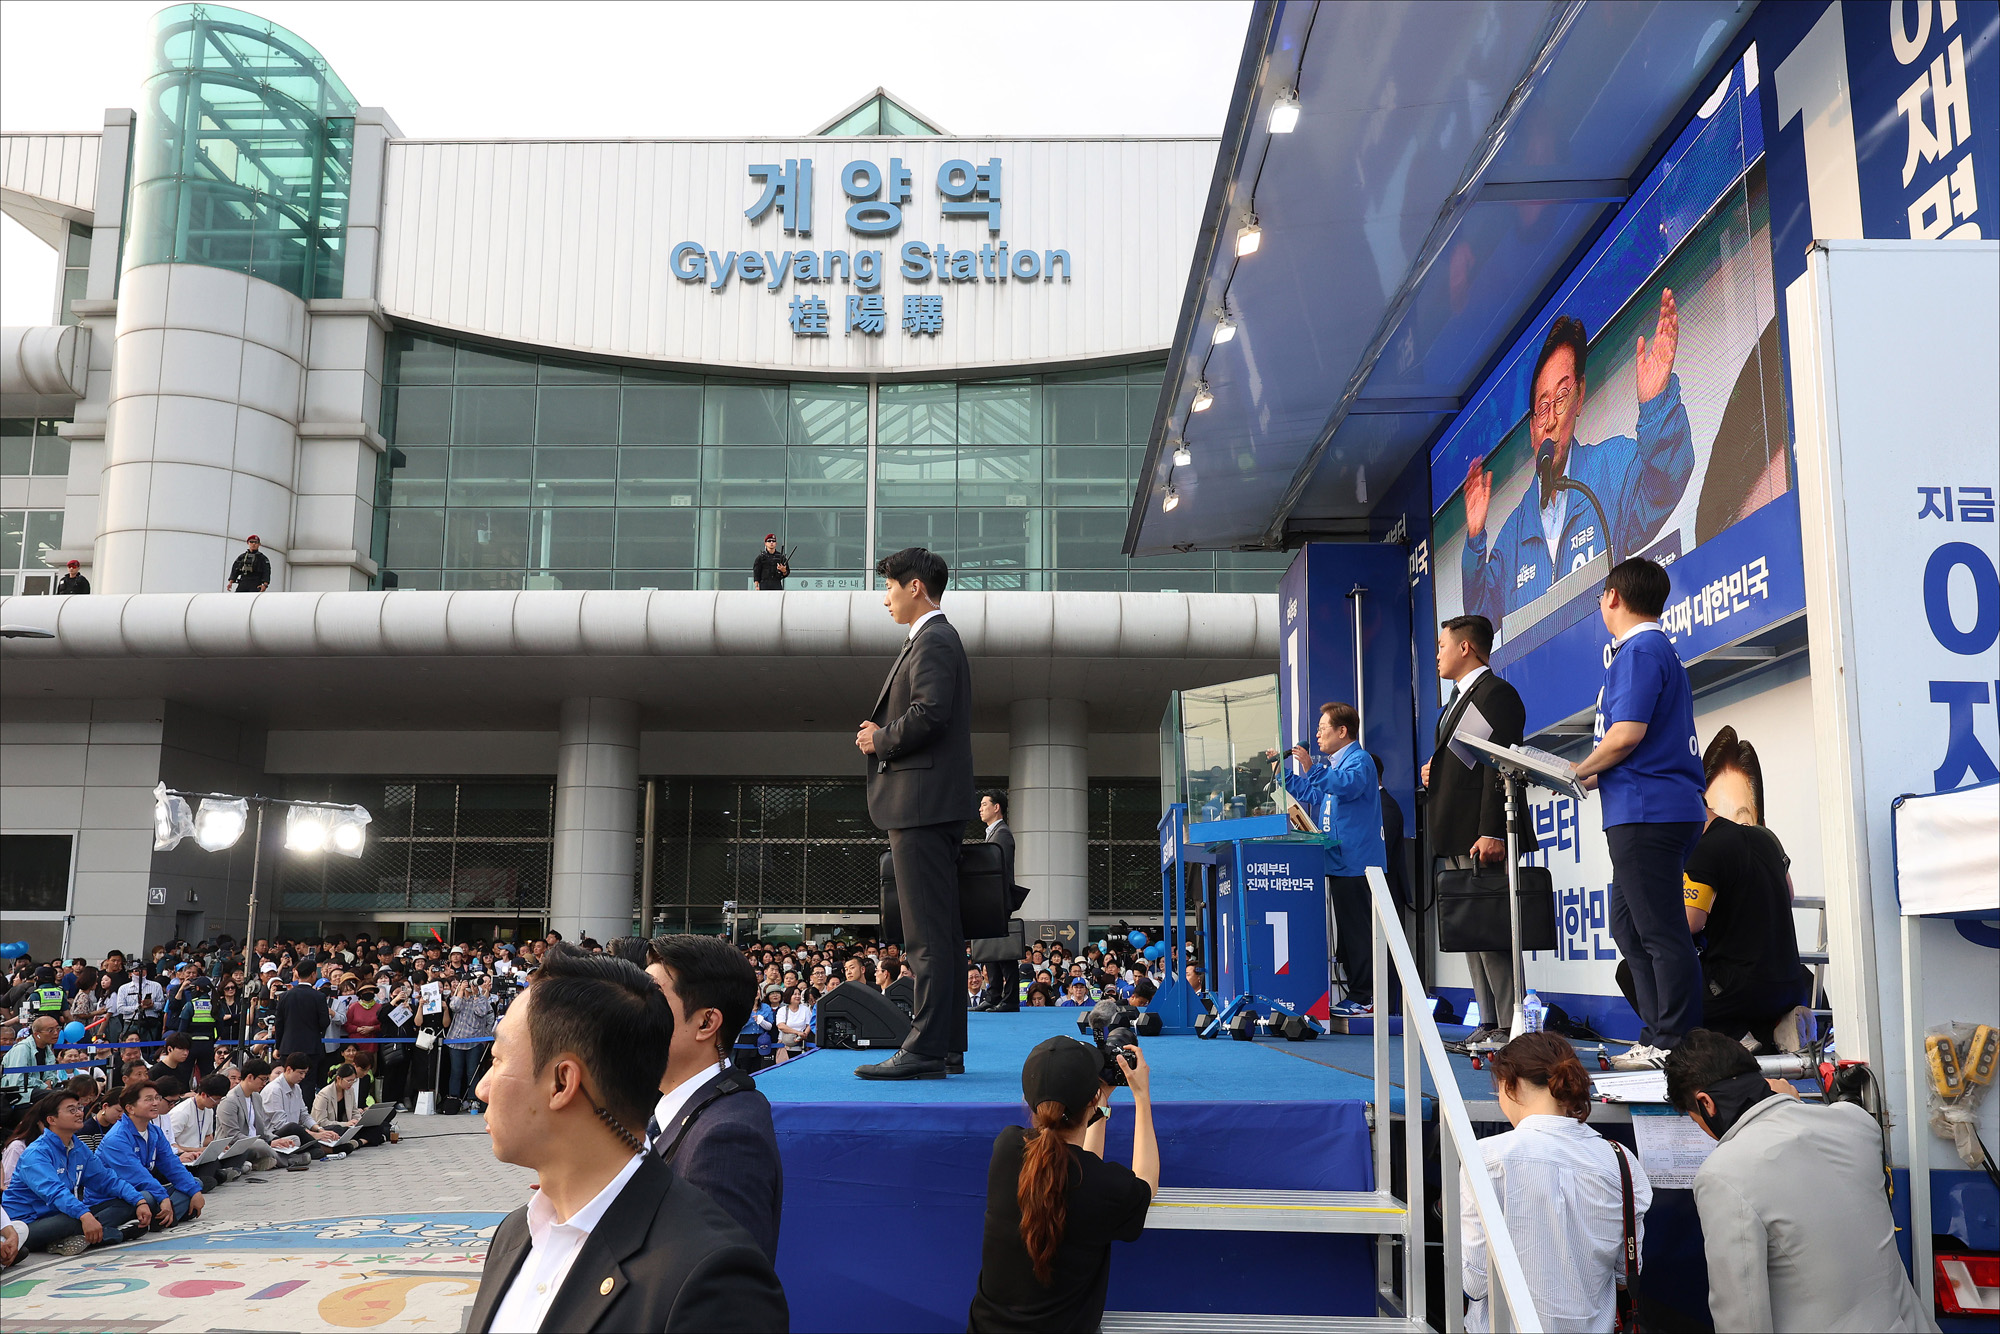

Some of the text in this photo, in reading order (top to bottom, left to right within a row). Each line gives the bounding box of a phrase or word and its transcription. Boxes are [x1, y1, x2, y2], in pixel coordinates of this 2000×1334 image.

[744, 157, 1002, 237] 계양역
[670, 240, 1071, 289] Gyeyang Station
[788, 294, 943, 337] 桂陽驛
[1570, 525, 1595, 551] 지금은
[814, 579, 865, 589] 종합안내
[1660, 555, 1769, 644] 진짜 대한민국
[1526, 797, 1580, 868] 부터
[1246, 863, 1290, 876] 이제부터
[1246, 878, 1269, 891] 진짜
[1270, 878, 1314, 891] 대한민국
[1265, 911, 1290, 975] 1
[1627, 1236, 1635, 1260] EOS
